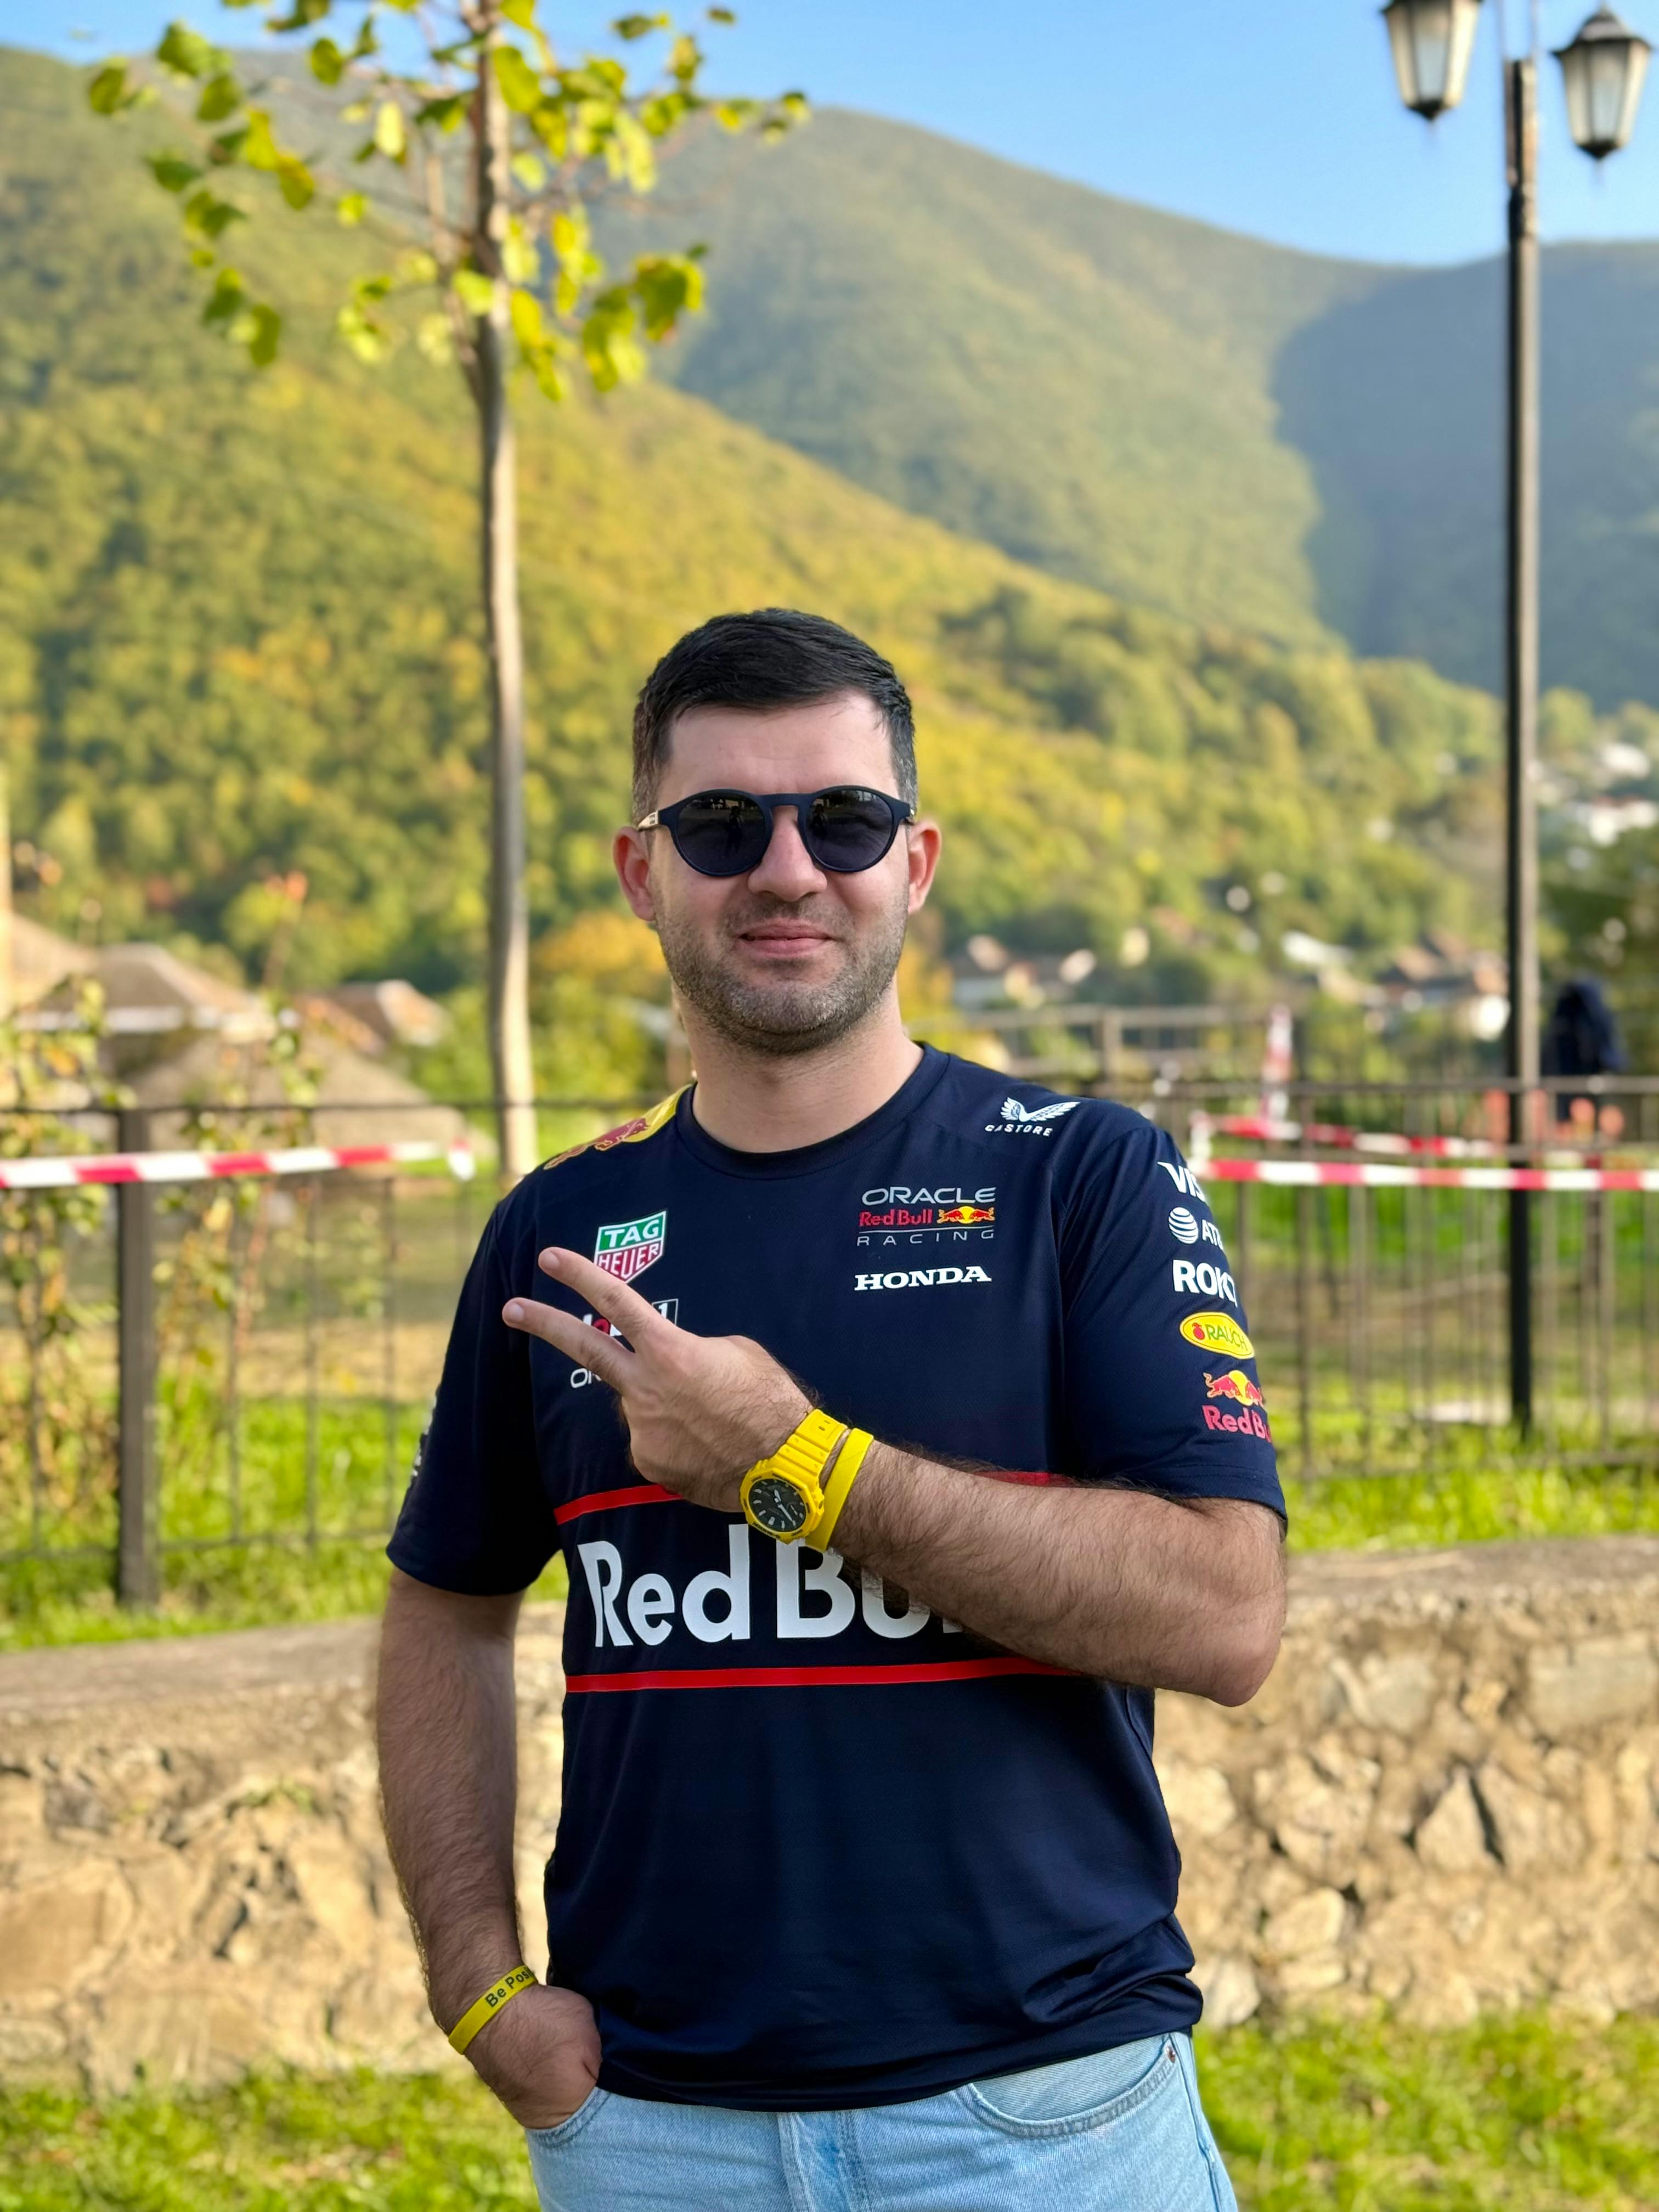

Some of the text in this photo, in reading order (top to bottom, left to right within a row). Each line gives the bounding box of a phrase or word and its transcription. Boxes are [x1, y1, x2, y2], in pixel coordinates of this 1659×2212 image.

[984, 1124, 1053, 1137] CASTORE
[861, 1186, 996, 1206] ORACLE
[859, 1209, 933, 1227] Red Bull
[604, 1219, 659, 1248] TAG
[856, 1229, 994, 1246] RACING
[597, 1243, 659, 1279] HEUER
[854, 1266, 992, 1291] HONDA
[1205, 1324, 1248, 1351] RAUCH
[1201, 1405, 1254, 1435] Red
[578, 1524, 963, 1647] Red Bu
[485, 1988, 506, 2007] Be
